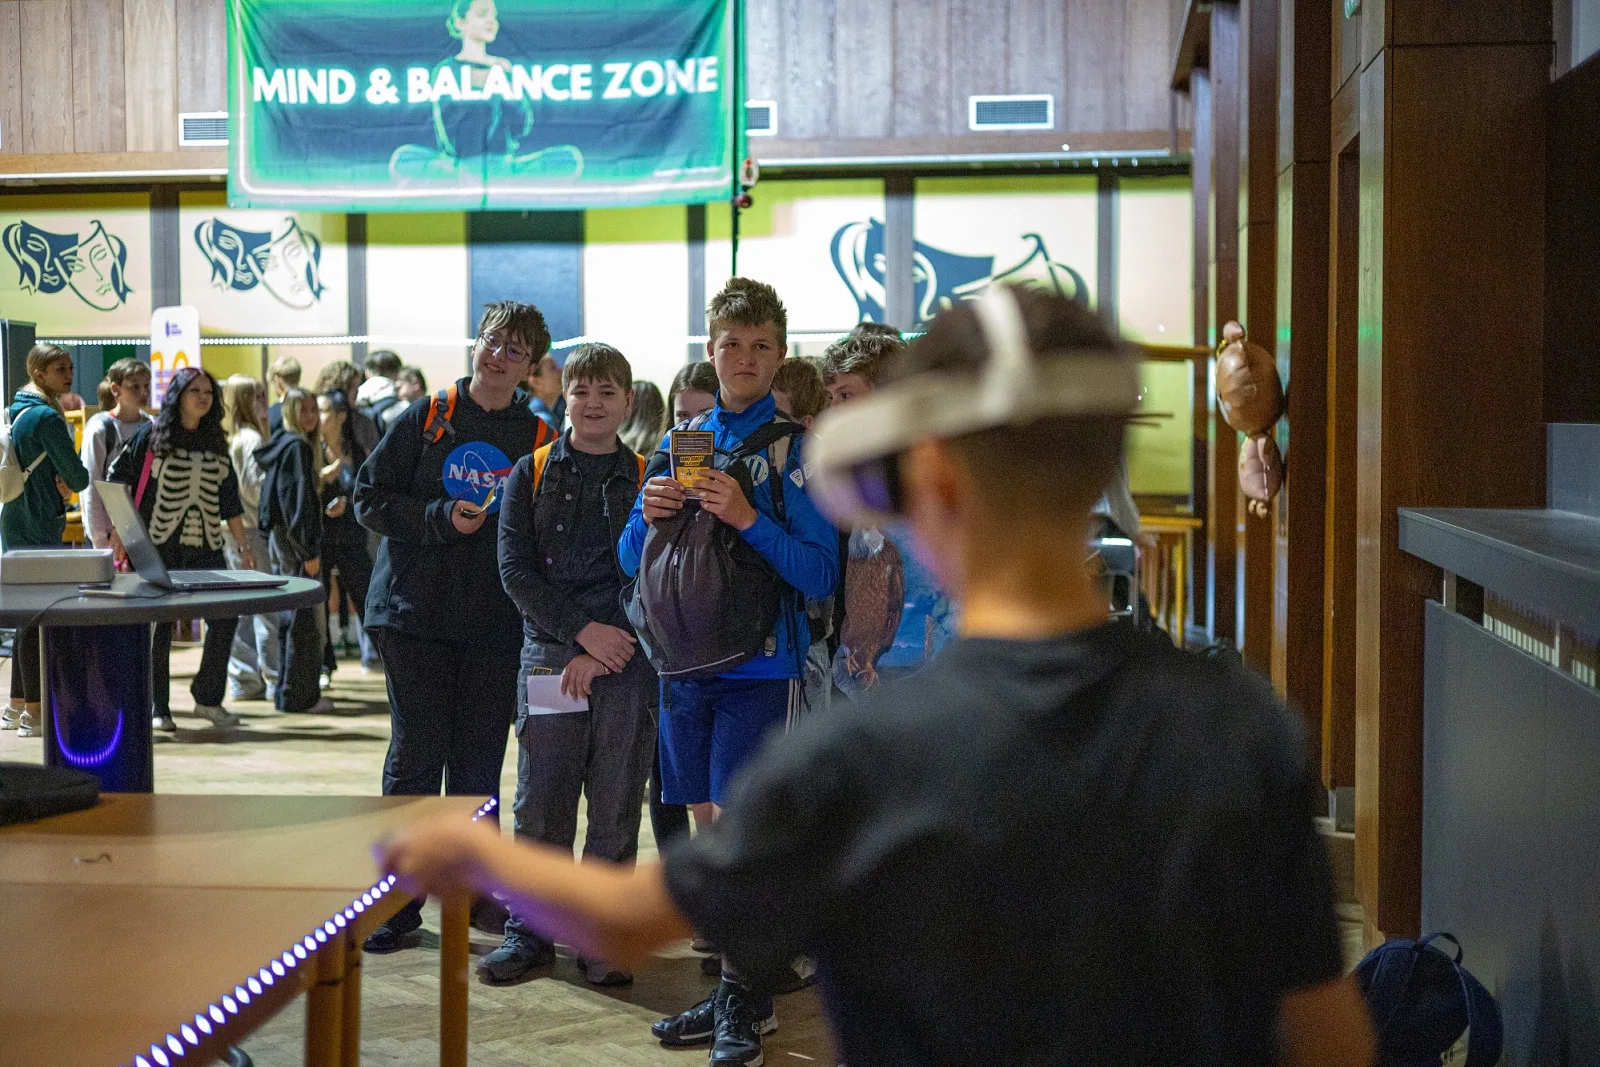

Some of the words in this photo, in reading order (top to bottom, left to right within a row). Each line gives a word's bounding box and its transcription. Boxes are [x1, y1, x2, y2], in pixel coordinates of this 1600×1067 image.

[253, 67, 355, 103] MIND
[365, 68, 399, 104] &
[408, 64, 592, 103] BALANCE
[603, 56, 718, 99] ZONE
[448, 463, 509, 491] NASA
